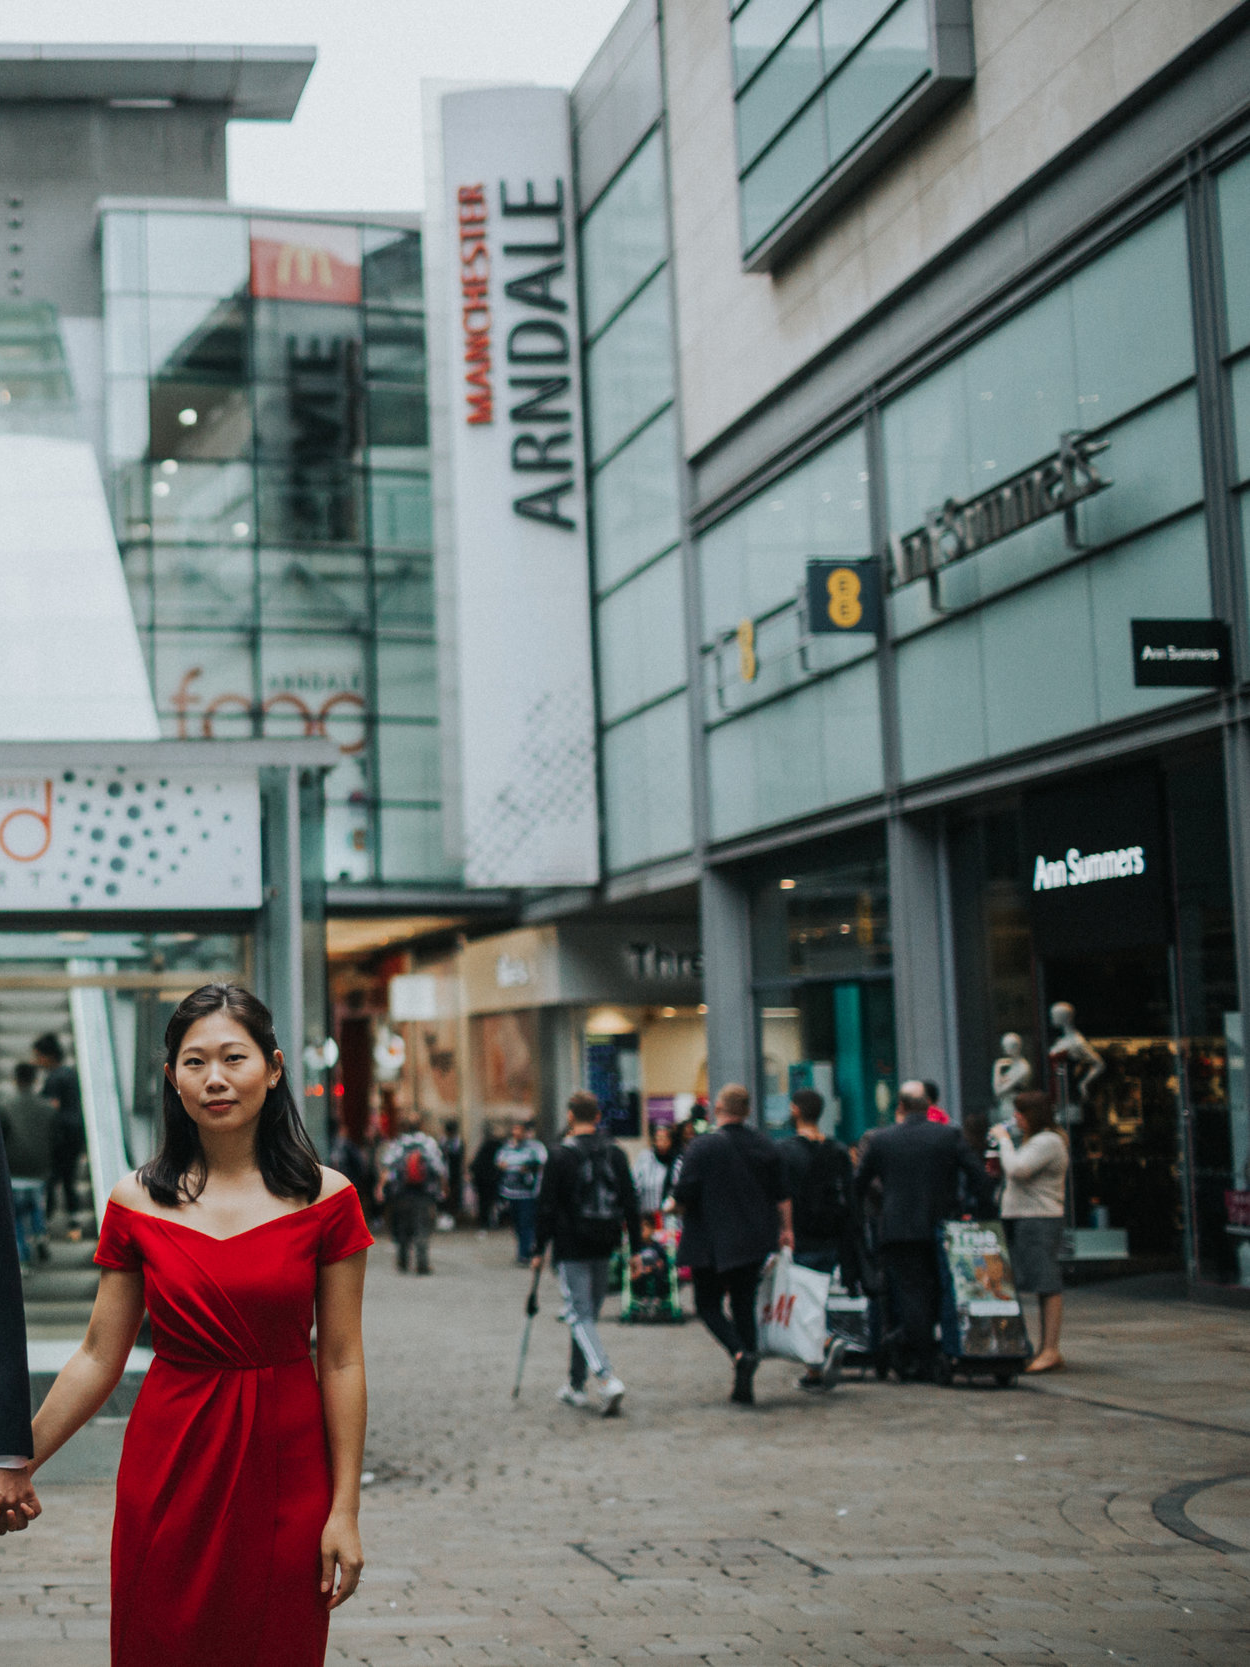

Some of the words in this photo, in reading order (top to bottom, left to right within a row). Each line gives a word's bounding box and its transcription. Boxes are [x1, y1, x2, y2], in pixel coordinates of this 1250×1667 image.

[458, 183, 493, 424] MANCHESTER
[500, 178, 576, 532] ARNDALE
[1141, 645, 1167, 661] Ann
[1167, 645, 1219, 661] Summers
[1033, 855, 1067, 891] Ann
[1066, 847, 1145, 886] Summers
